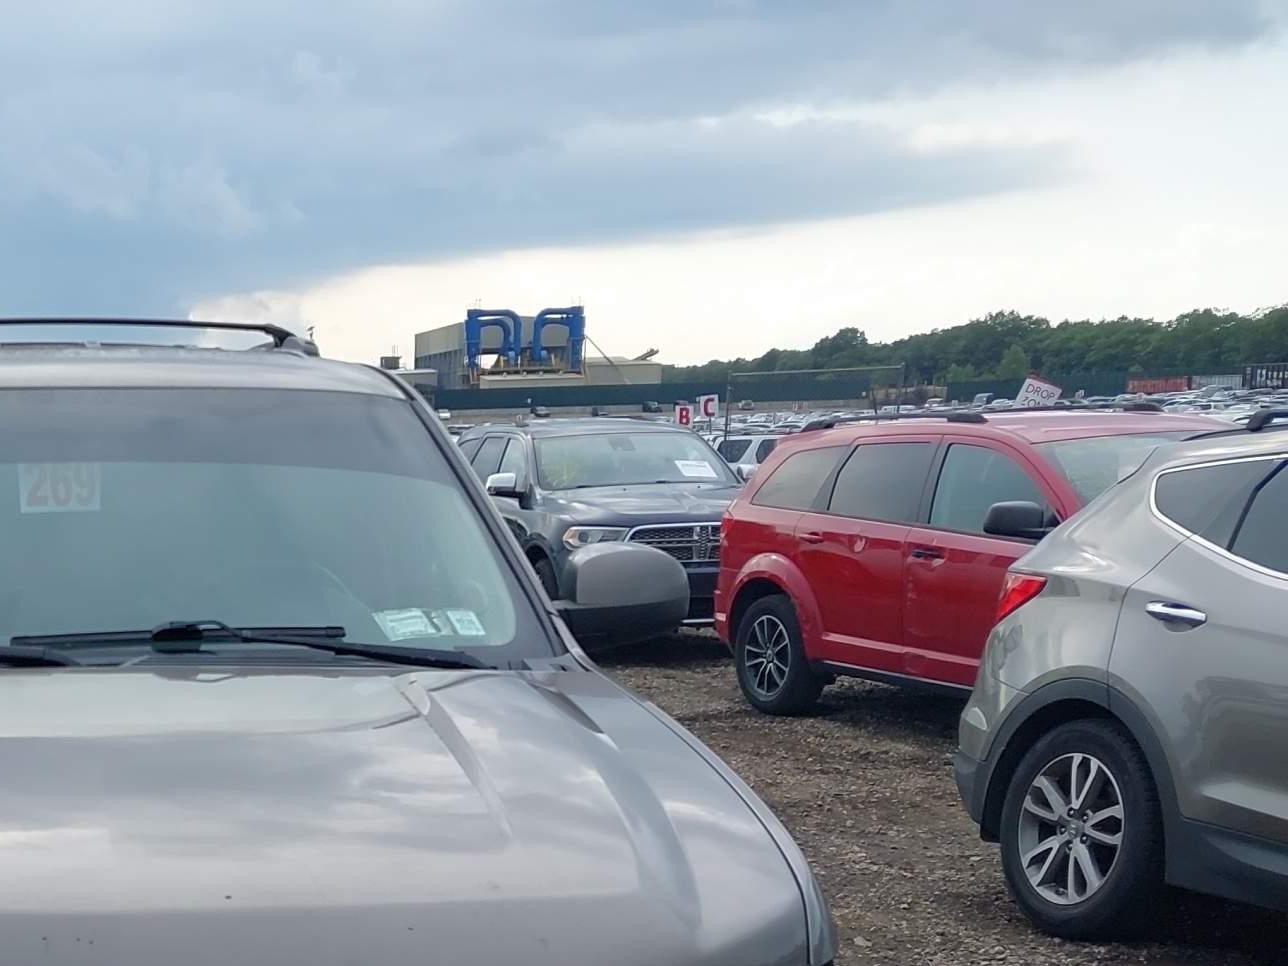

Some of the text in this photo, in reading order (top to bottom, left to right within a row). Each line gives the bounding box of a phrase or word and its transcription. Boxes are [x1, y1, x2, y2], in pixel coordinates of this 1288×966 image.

[1025, 383, 1057, 401] DROP
[679, 407, 690, 426] B
[703, 397, 716, 417] C
